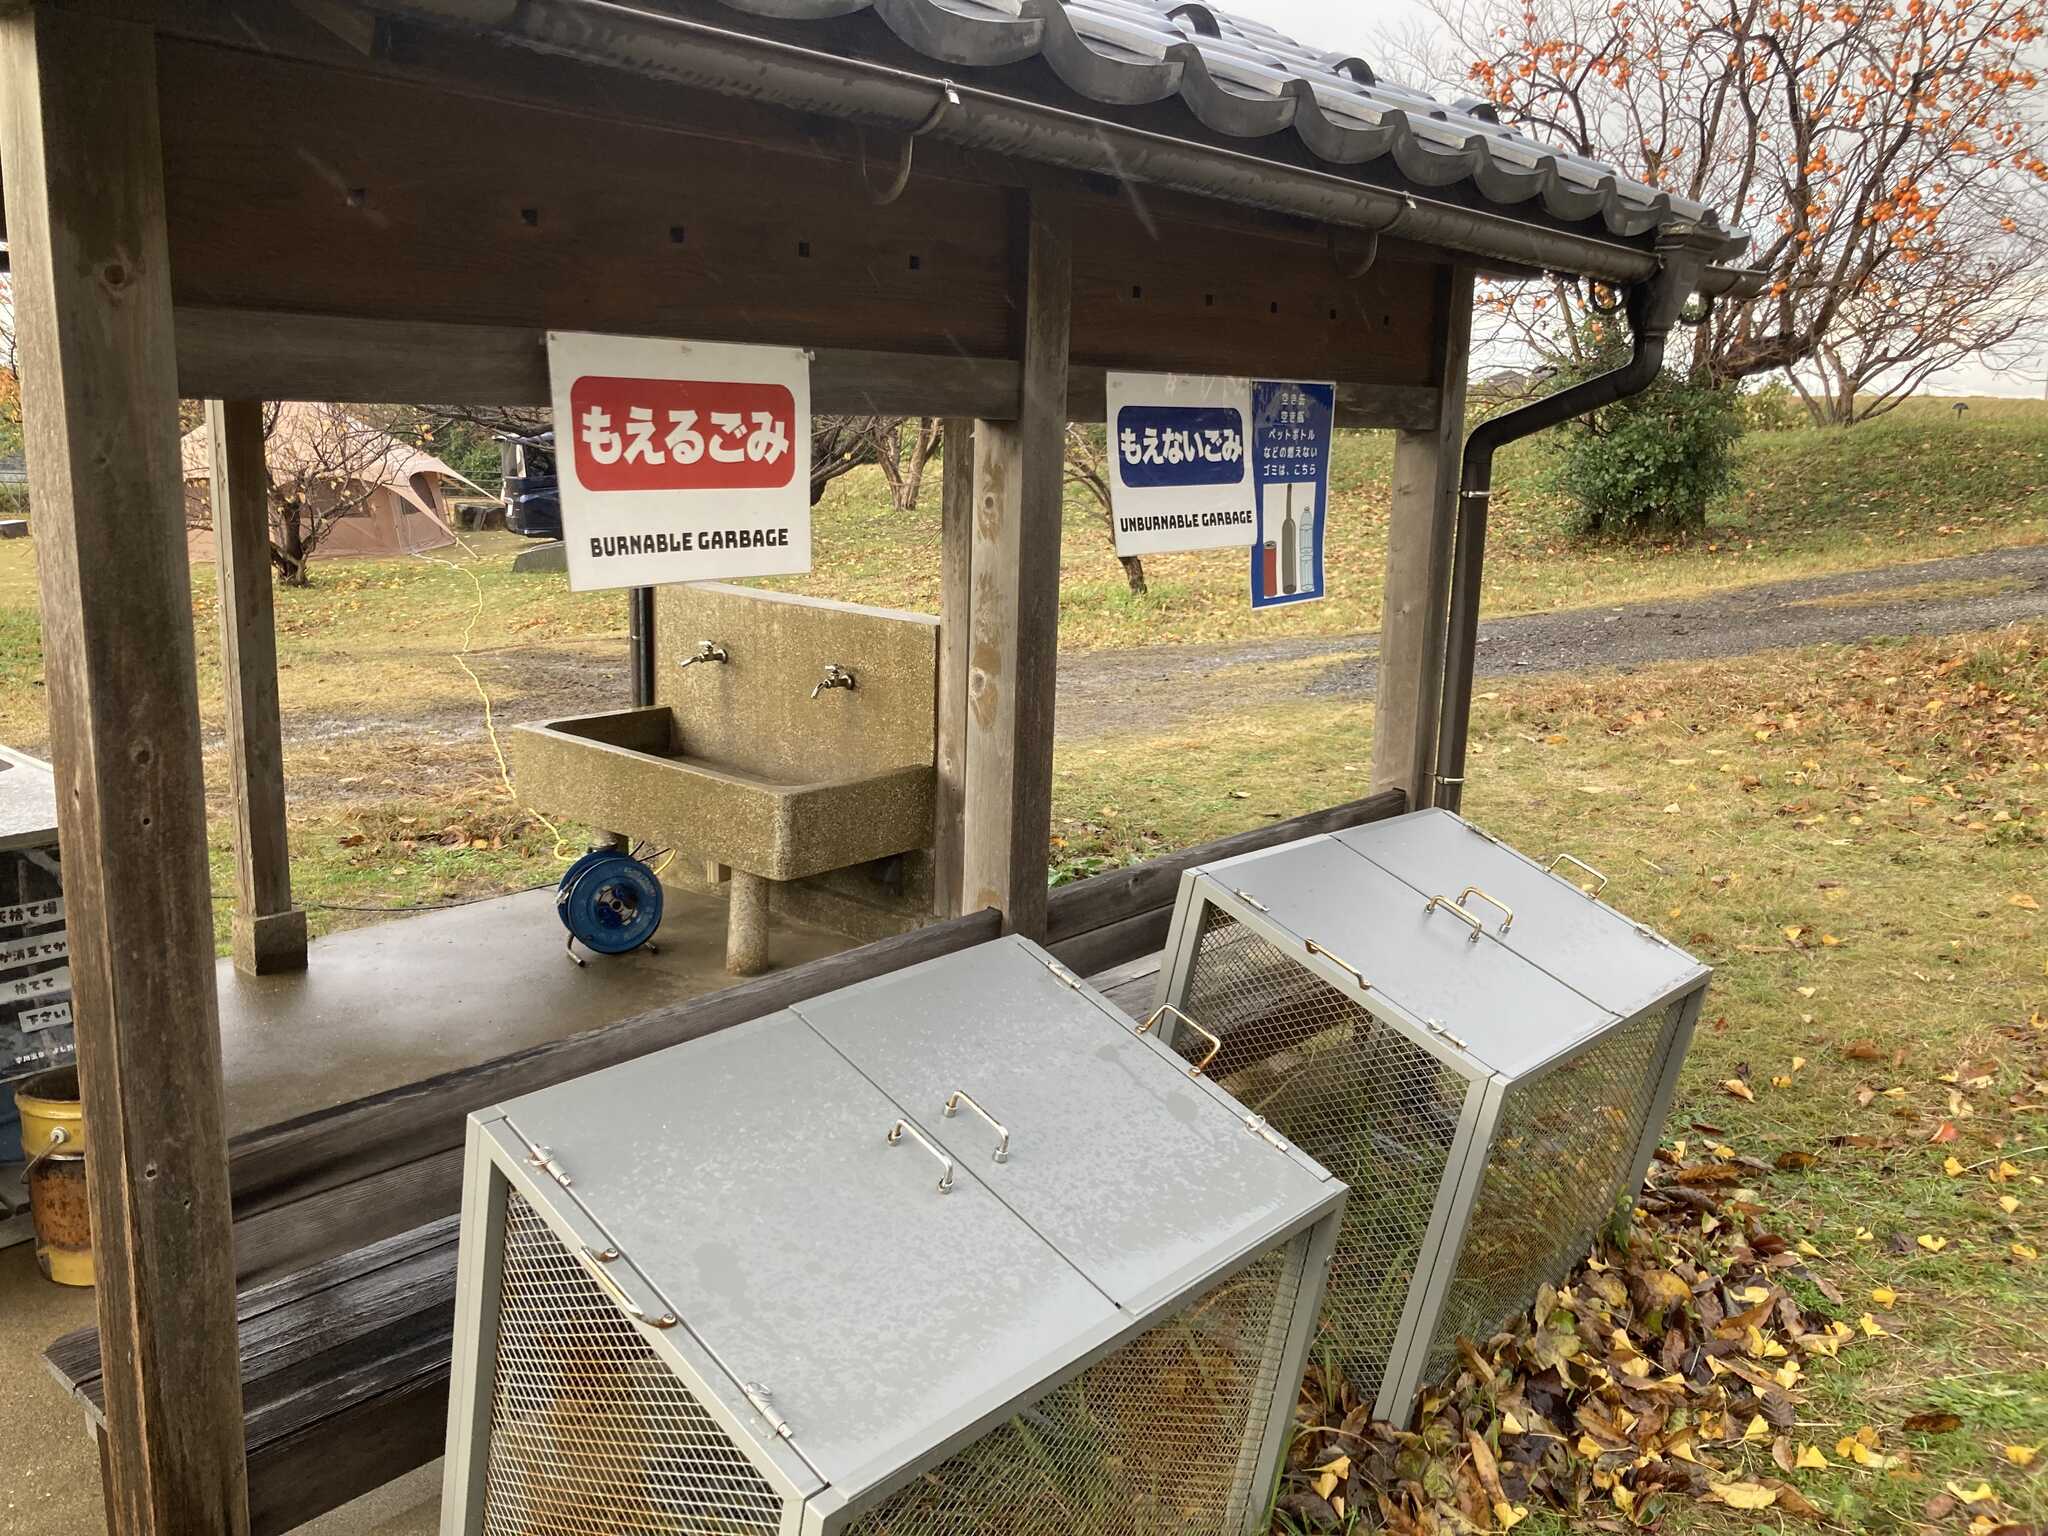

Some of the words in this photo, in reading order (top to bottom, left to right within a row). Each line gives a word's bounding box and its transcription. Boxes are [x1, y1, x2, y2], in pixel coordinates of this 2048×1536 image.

[582, 405, 790, 465] もえるごみ
[1268, 428, 1315, 440] ペットボトル
[1120, 427, 1243, 465] もえないごみ
[1263, 446, 1318, 459] などの燃えない
[1120, 513, 1199, 533] UNBURNABLE
[1201, 510, 1253, 527] GARBAGE
[590, 532, 693, 558] BURNABLE
[698, 528, 789, 550] GARBAGE
[25, 1009, 66, 1026] 下さい
